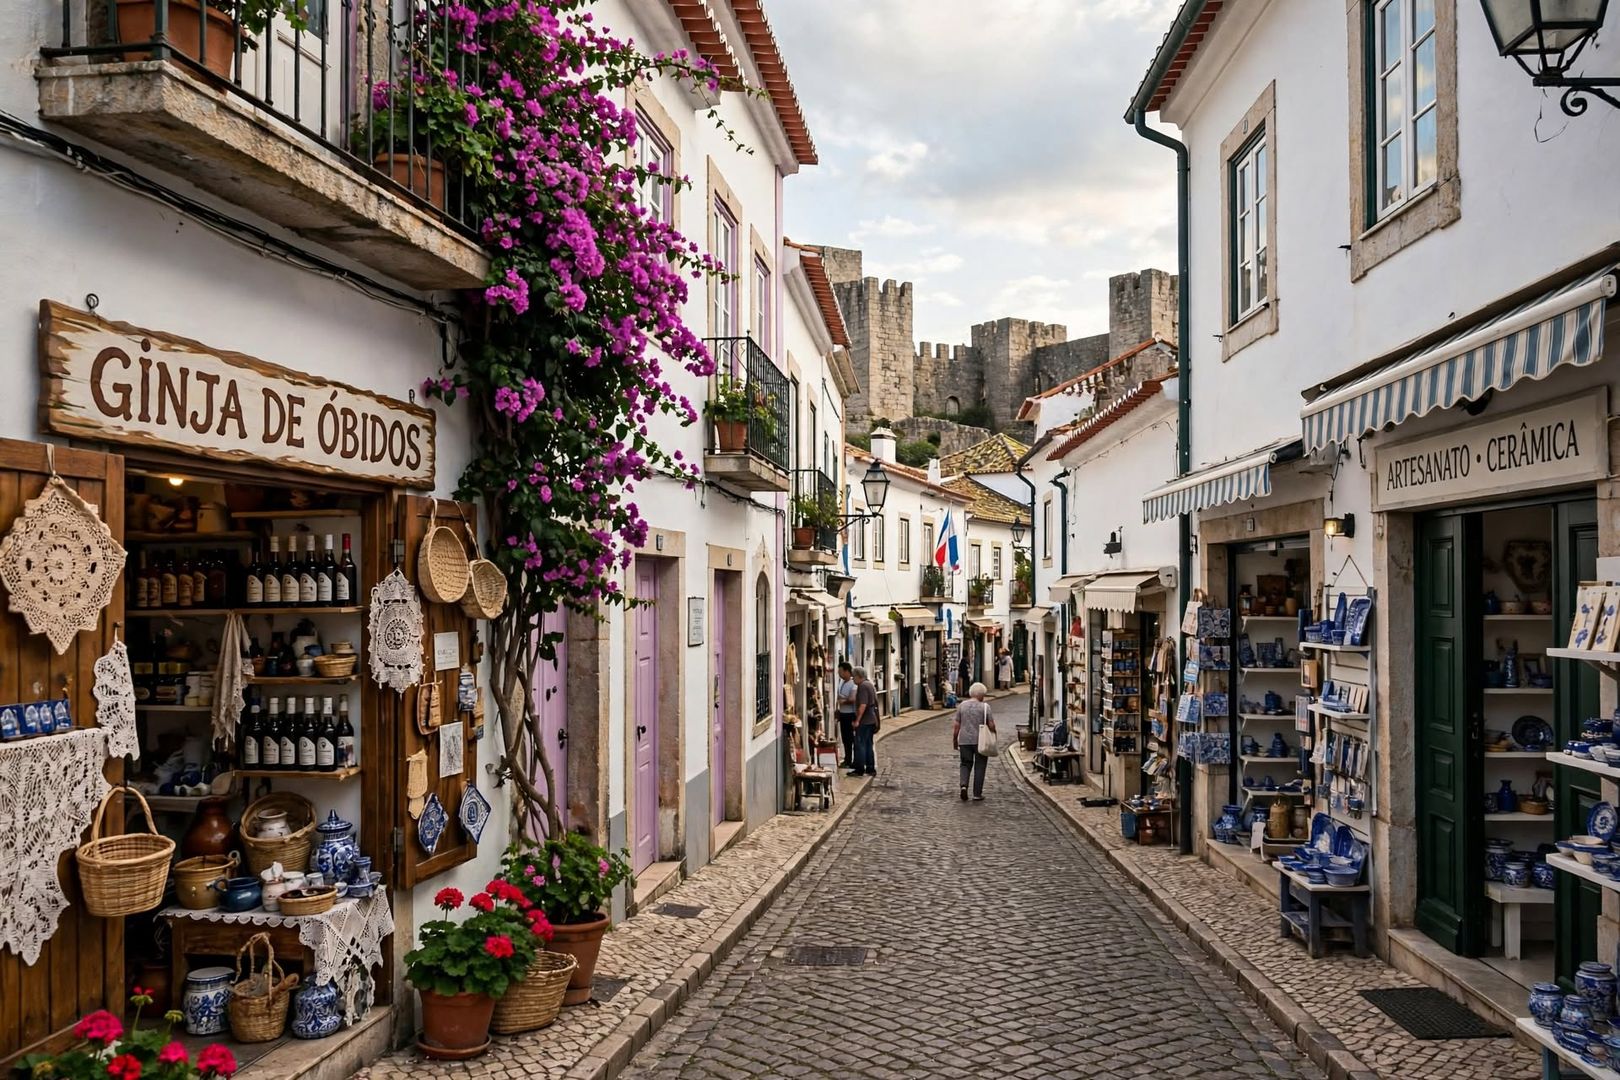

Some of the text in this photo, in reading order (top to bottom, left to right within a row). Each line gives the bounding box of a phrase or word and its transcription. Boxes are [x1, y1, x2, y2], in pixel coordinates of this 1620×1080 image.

[262, 387, 306, 449] DE
[318, 389, 422, 472] ÓBIDOS
[1386, 443, 1471, 491] ARTESANATO
[1486, 419, 1580, 473] CERÂMICA
